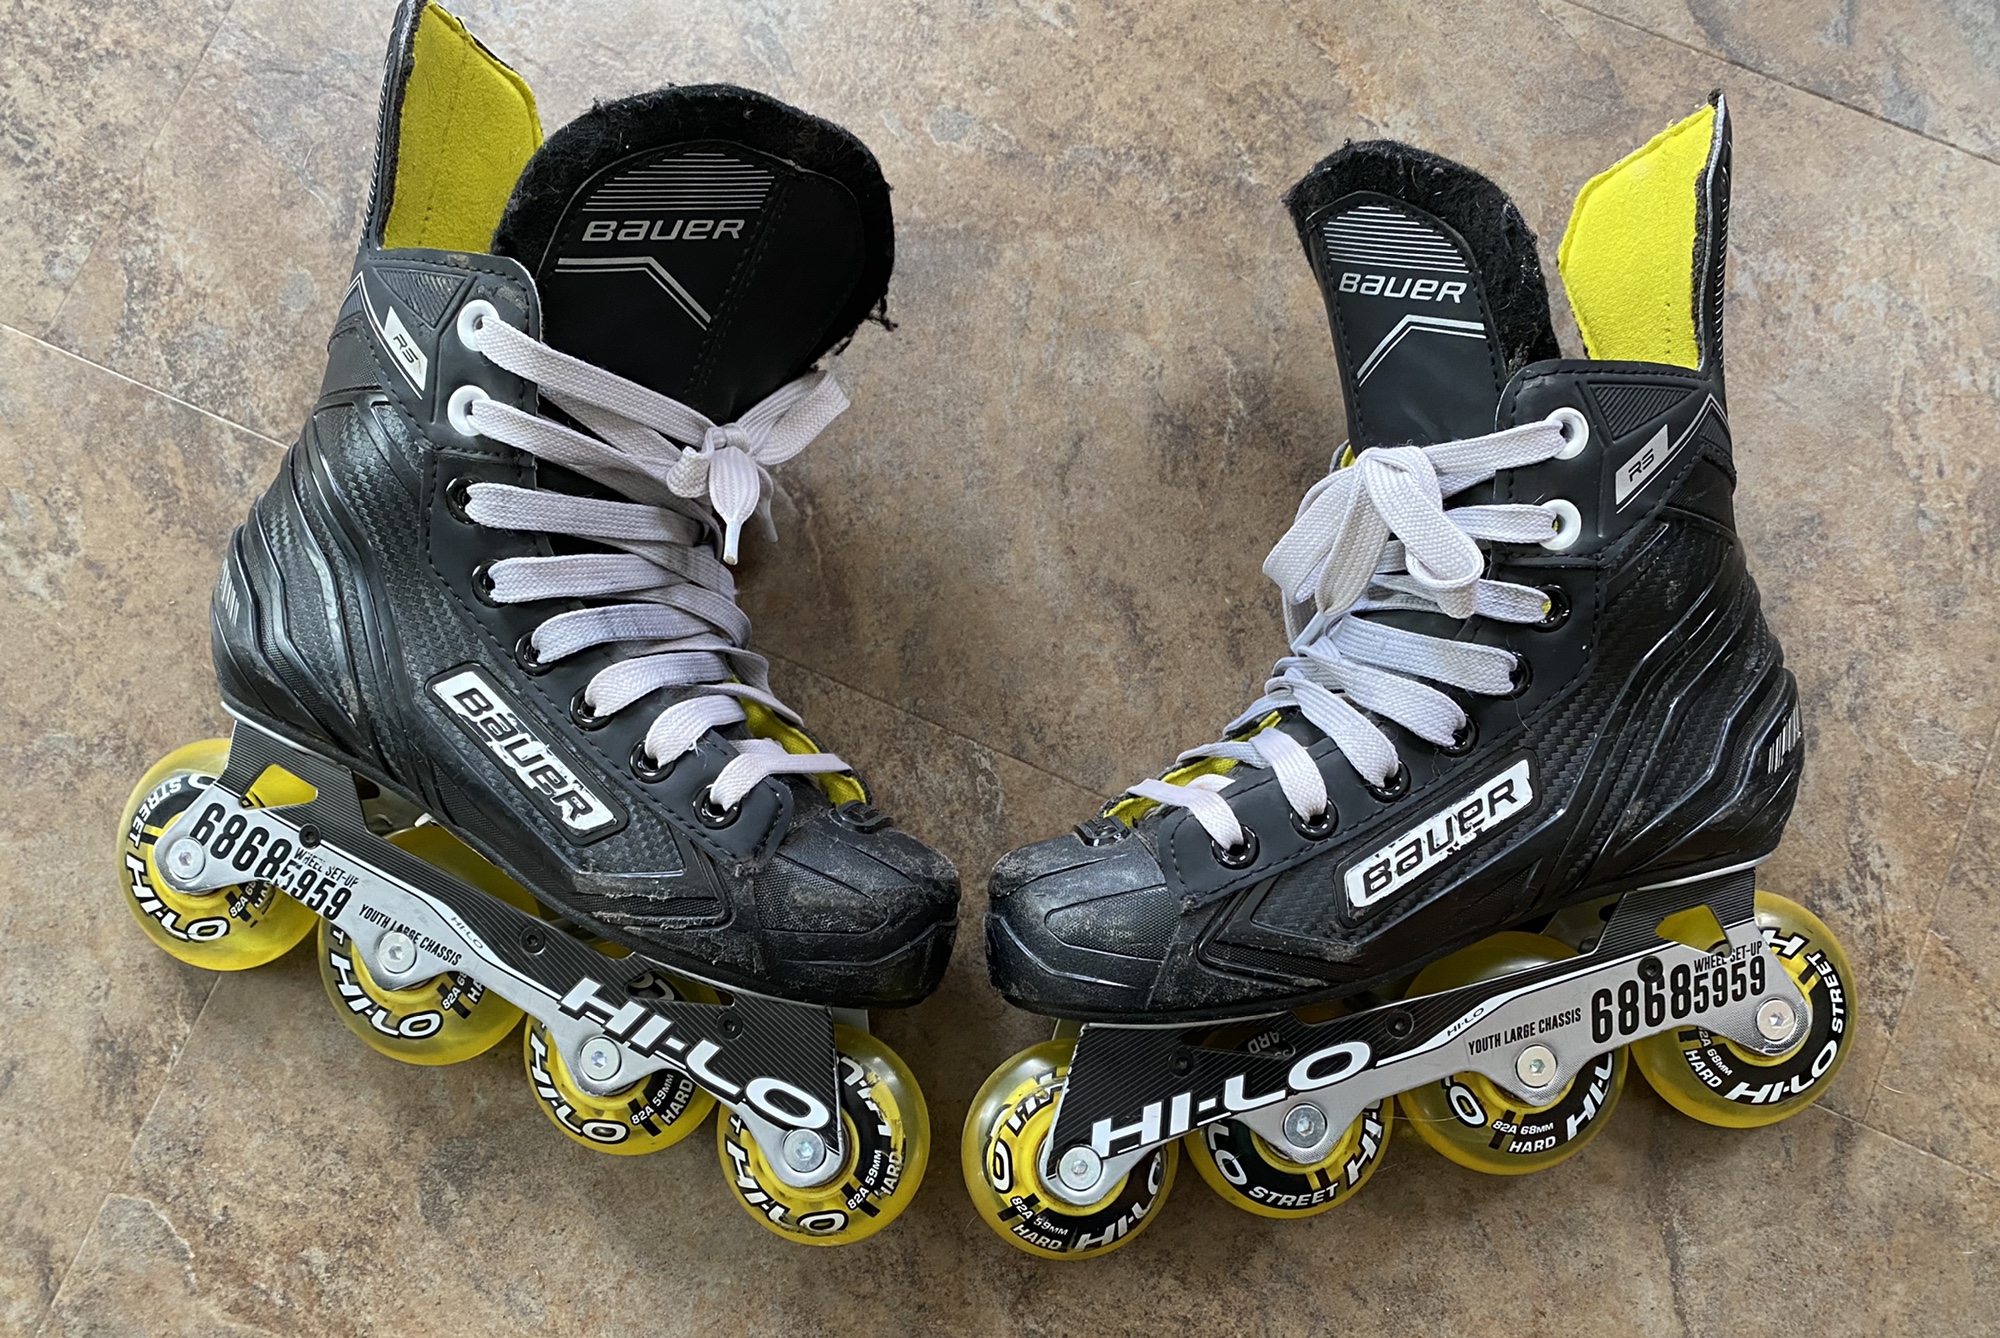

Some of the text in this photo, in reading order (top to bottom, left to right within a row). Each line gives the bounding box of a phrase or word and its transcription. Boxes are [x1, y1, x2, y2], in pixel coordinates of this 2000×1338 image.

[393, 333, 419, 364] RS
[1628, 447, 1655, 482] RS
[127, 777, 182, 849] STREET
[125, 853, 229, 941] HI-LO
[230, 896, 248, 917] 82A
[359, 904, 391, 929] YOUTH
[419, 936, 462, 966] CHASSIS
[451, 916, 484, 949] HI-LO
[1730, 940, 1762, 962] SET-UP
[330, 951, 442, 1038] HI-LO
[442, 987, 461, 1010] 82A
[1807, 952, 1845, 1034] STREET
[1447, 1007, 1485, 1037] HI-LO
[1468, 1007, 1581, 1055] YOUTH LARGE CHASSIS
[560, 976, 831, 1130] HI-LO
[1685, 1049, 1723, 1087] HARD
[1698, 1027, 1733, 1076] 2A 68MM
[1724, 1040, 1838, 1103] HI-LO
[530, 1032, 628, 1142] HI-LO
[631, 1073, 674, 1125] 82A 59MM
[660, 1078, 693, 1125] HARD
[1091, 1041, 1371, 1158] HI-LO
[1492, 1120, 1554, 1136] 82A 68MM
[1508, 1135, 1556, 1153] HARD
[847, 1149, 882, 1210] 82A 59MM
[1249, 1183, 1338, 1207] STREET
[1012, 1197, 1069, 1237] 82A 59MM
[1013, 1223, 1063, 1251] HARD
